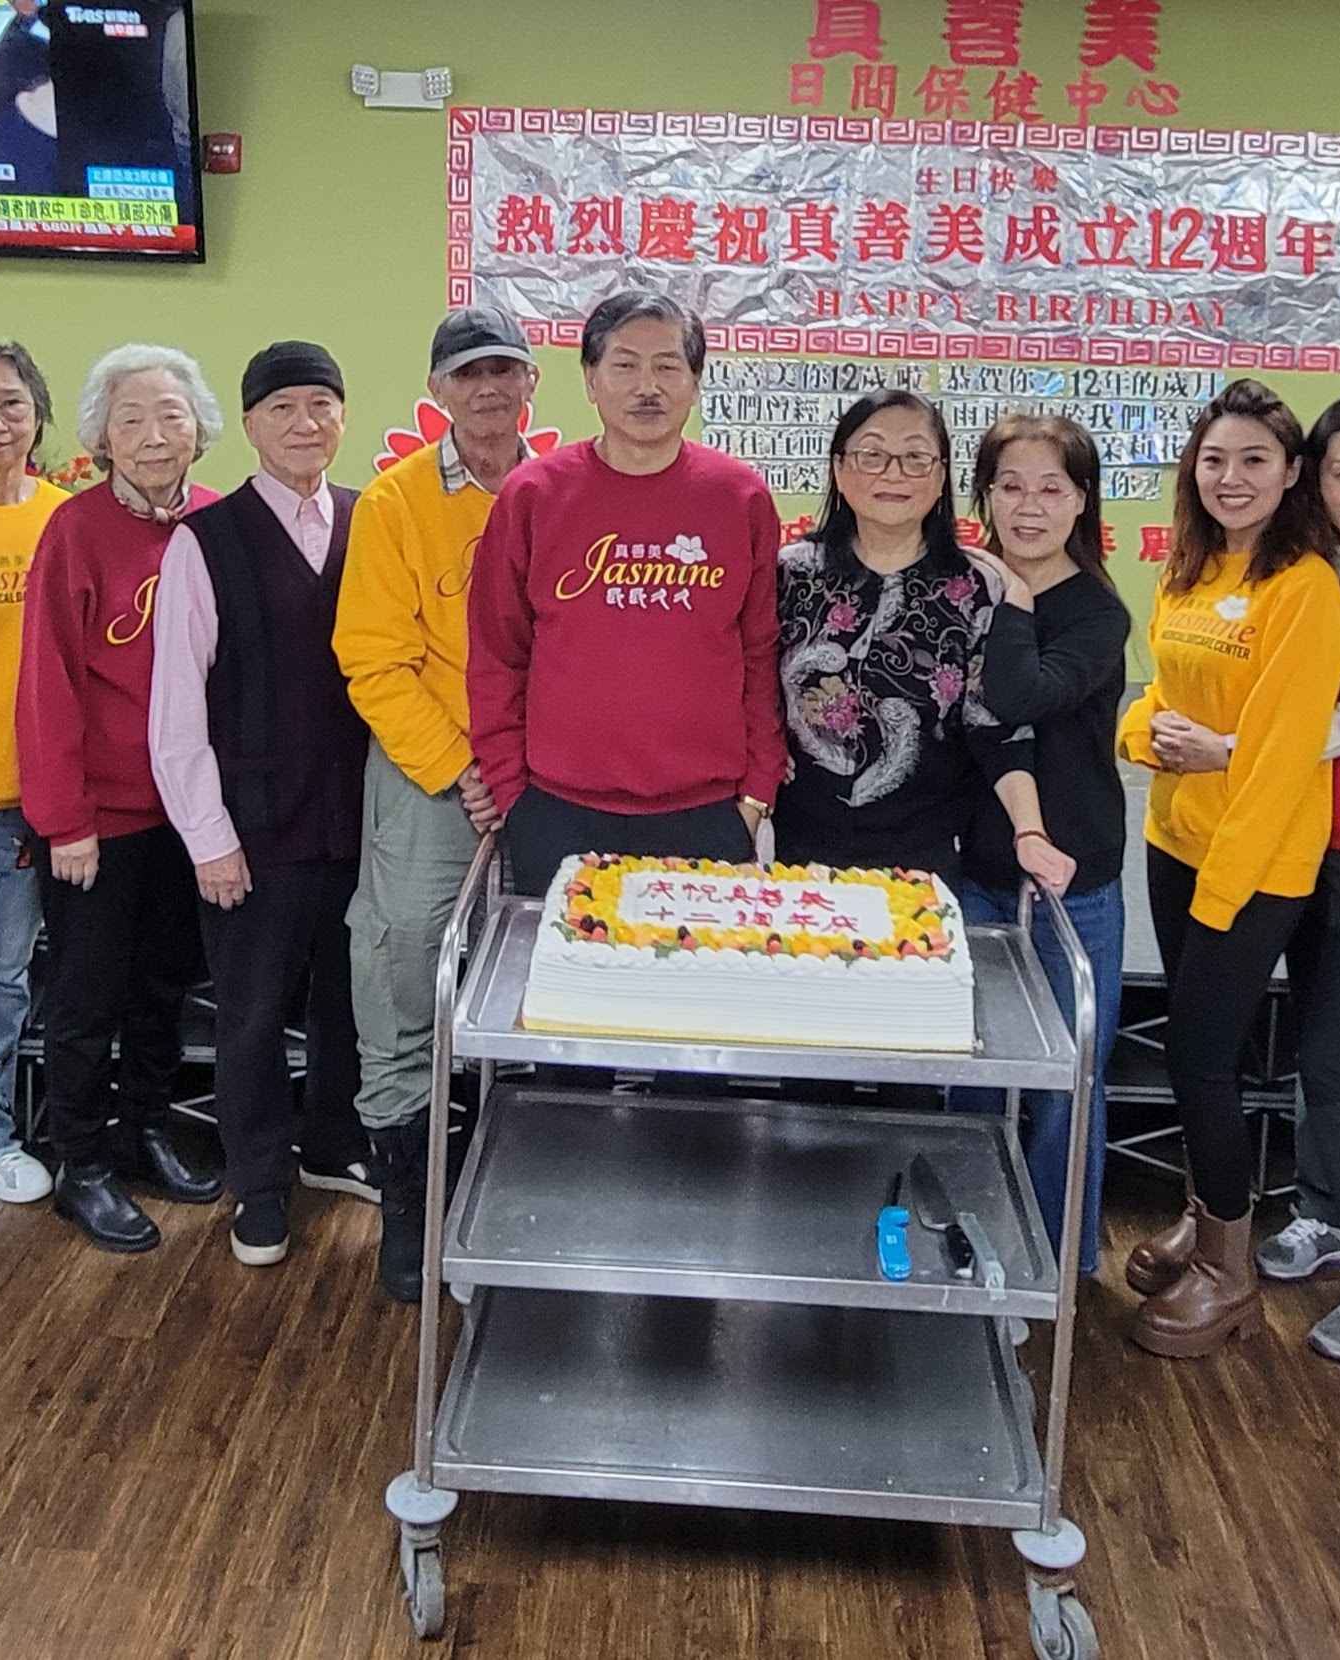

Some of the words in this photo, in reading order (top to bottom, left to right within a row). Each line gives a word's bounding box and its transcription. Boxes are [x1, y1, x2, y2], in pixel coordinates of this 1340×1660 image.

[788, 63, 1180, 128] 日間保健中心
[916, 166, 1059, 196] 生日快樂
[812, 287, 964, 322] HAPPY
[995, 293, 1230, 328] BIRTHDAY
[555, 533, 725, 600] Jasmine
